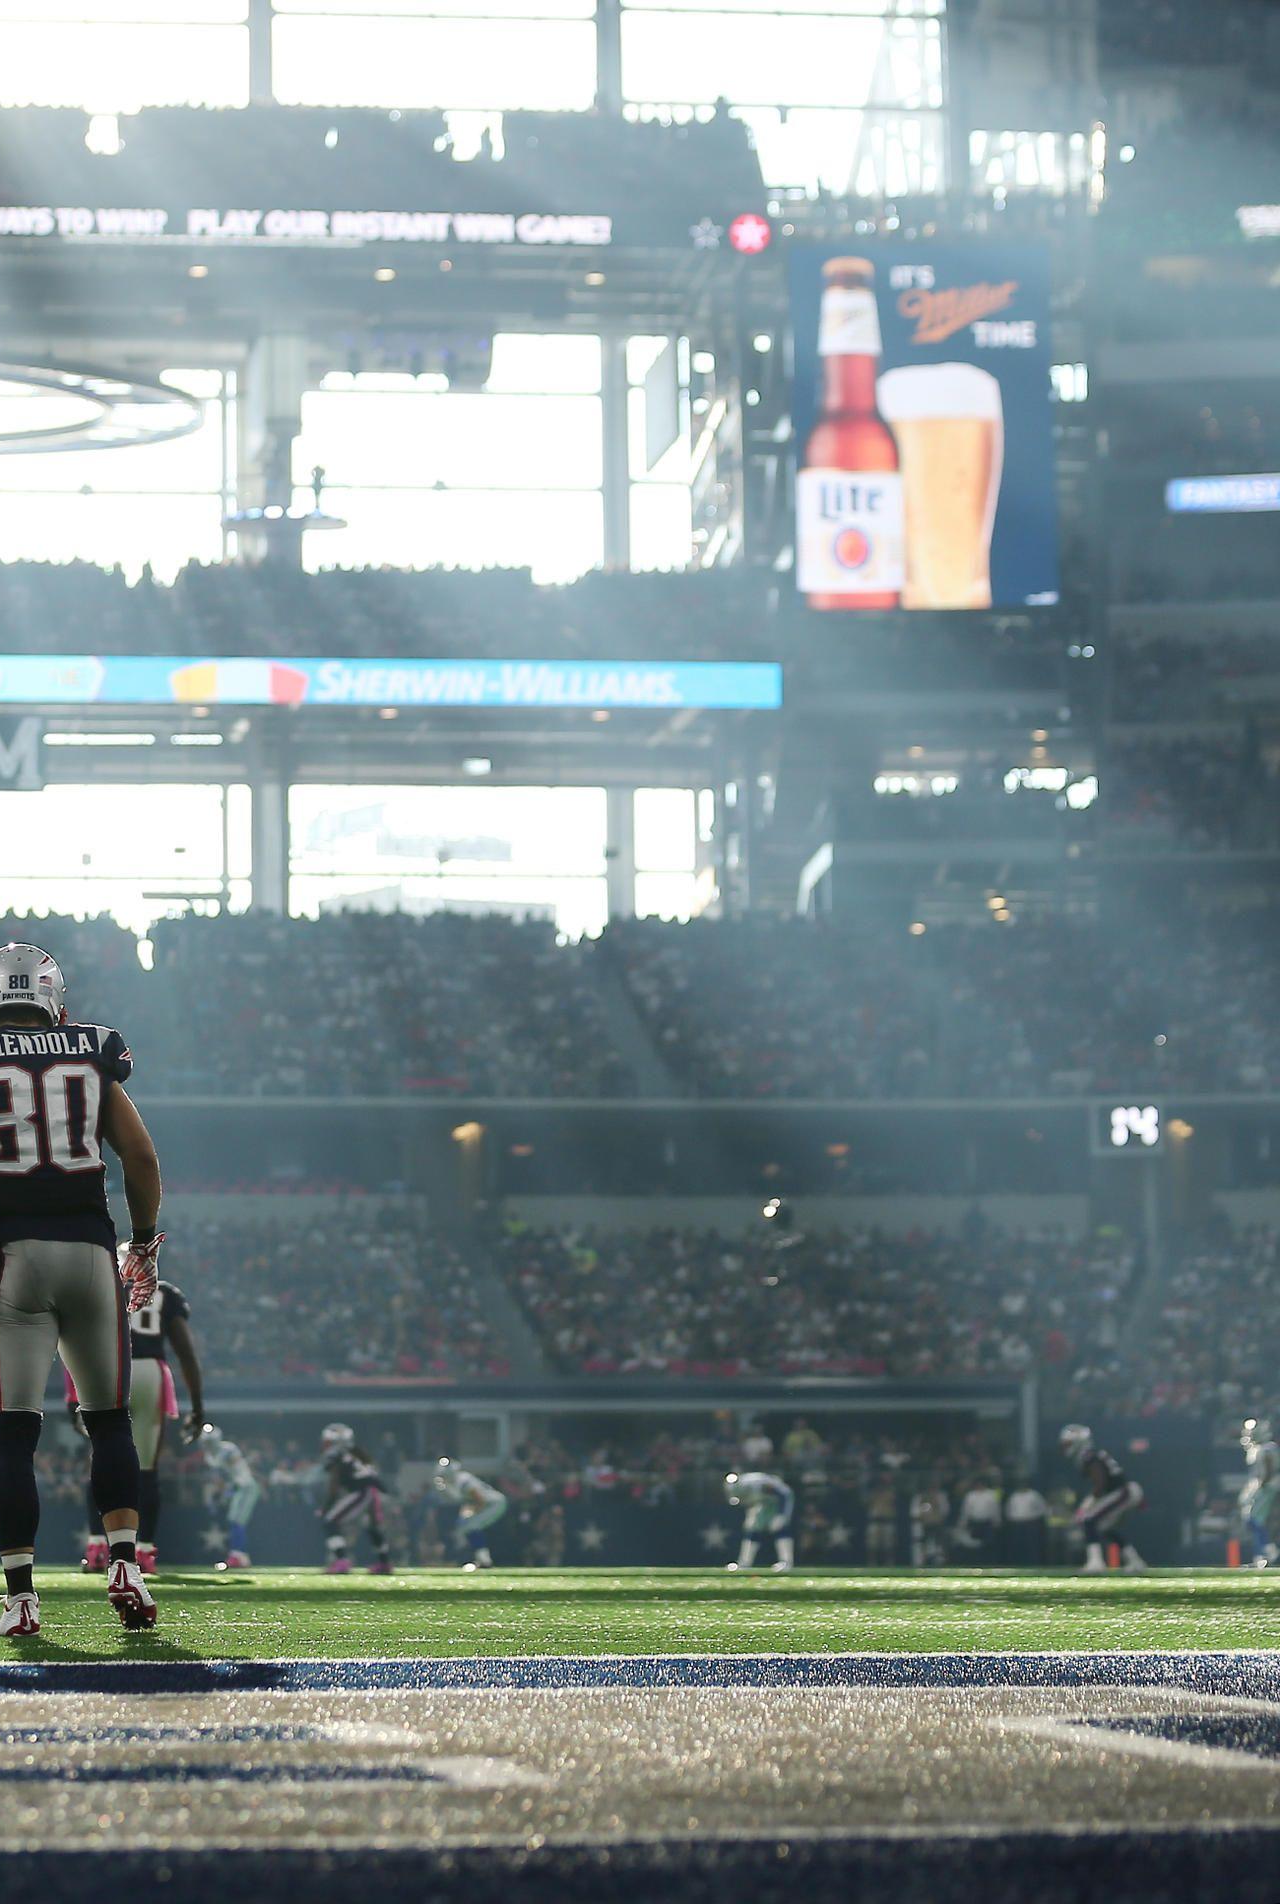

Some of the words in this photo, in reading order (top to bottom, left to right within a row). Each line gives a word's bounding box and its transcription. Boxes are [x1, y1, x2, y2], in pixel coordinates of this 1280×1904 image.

[56, 208, 94, 235] TO
[96, 209, 168, 235] WIN?
[187, 209, 261, 236] PLAY
[263, 210, 330, 237] OUR
[331, 211, 451, 240] INSTANT
[453, 214, 514, 241] WIN
[972, 321, 1036, 348] TIME
[9, 975, 29, 989] 80
[2, 993, 35, 1001] PATRIOTS
